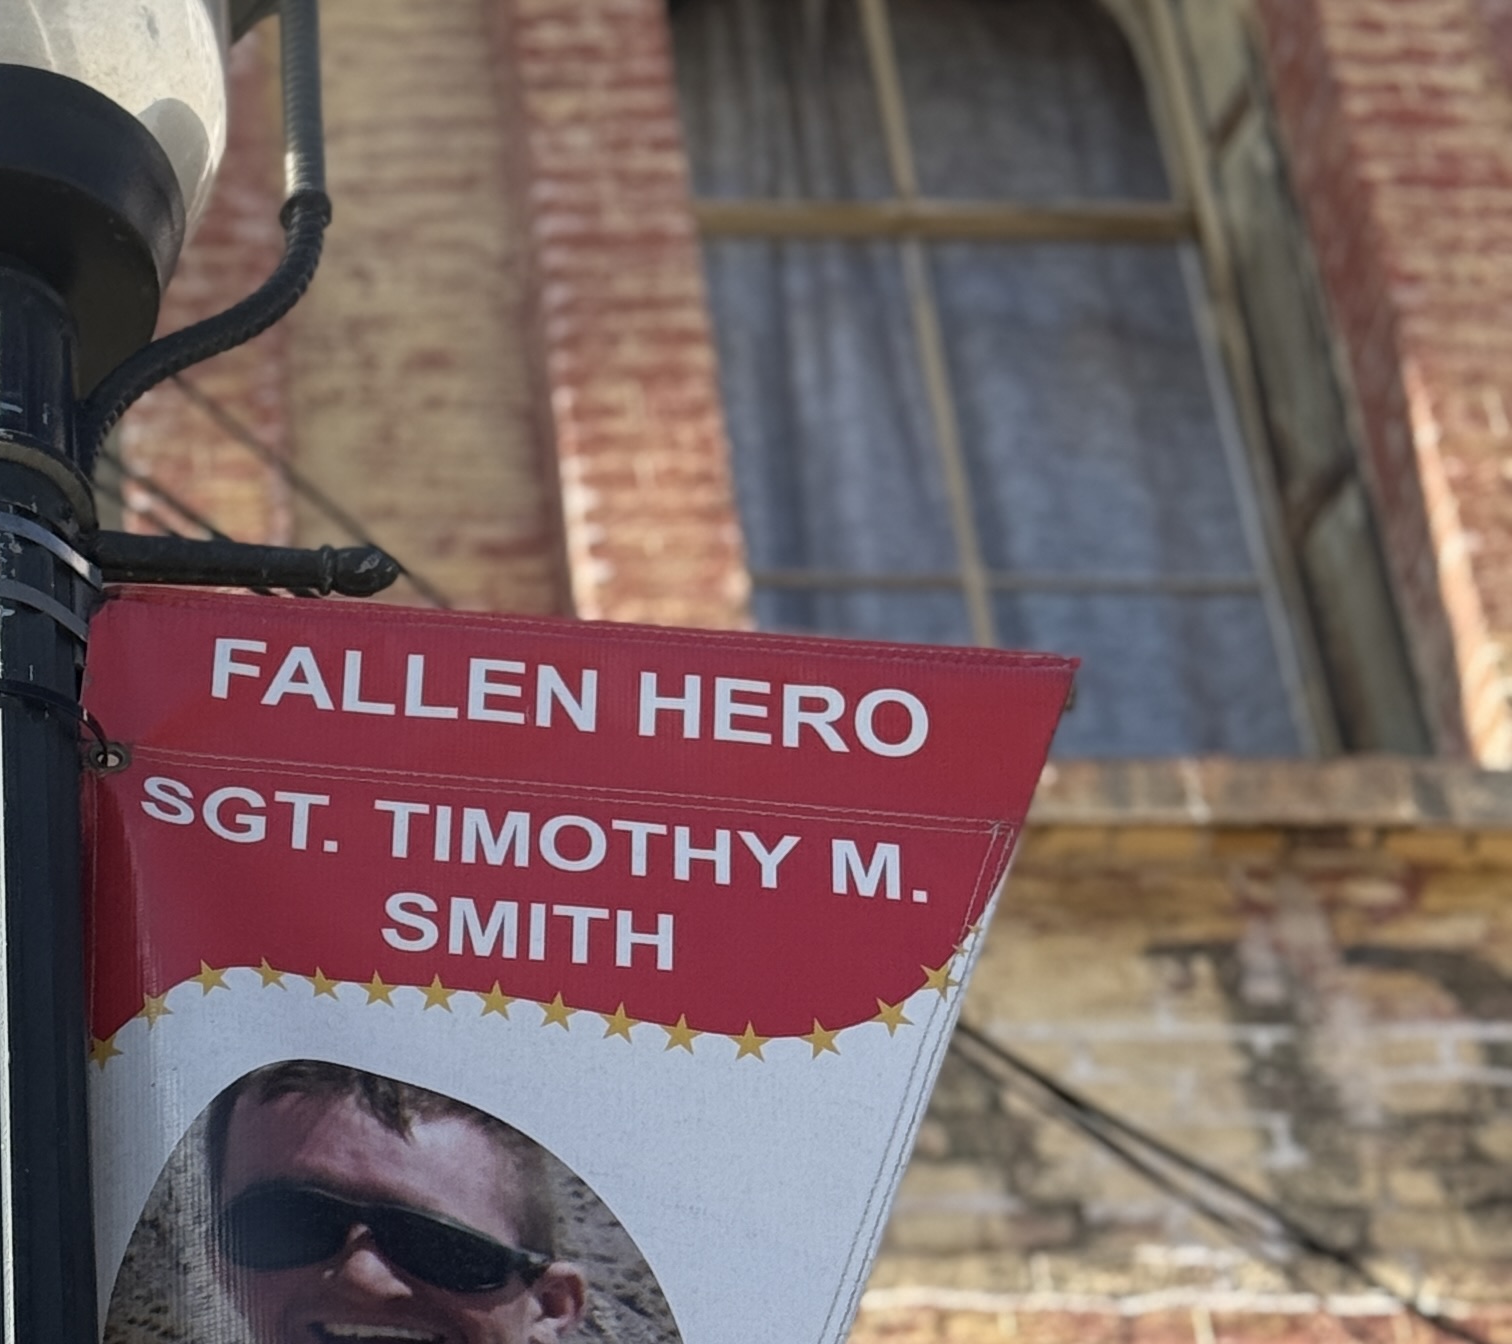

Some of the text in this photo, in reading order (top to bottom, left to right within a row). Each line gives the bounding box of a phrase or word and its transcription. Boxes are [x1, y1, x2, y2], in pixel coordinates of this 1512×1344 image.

[210, 636, 930, 758] FALLEN HERO
[138, 775, 929, 904] SGT. TIMOTHY M.
[380, 891, 675, 972] SMITH
